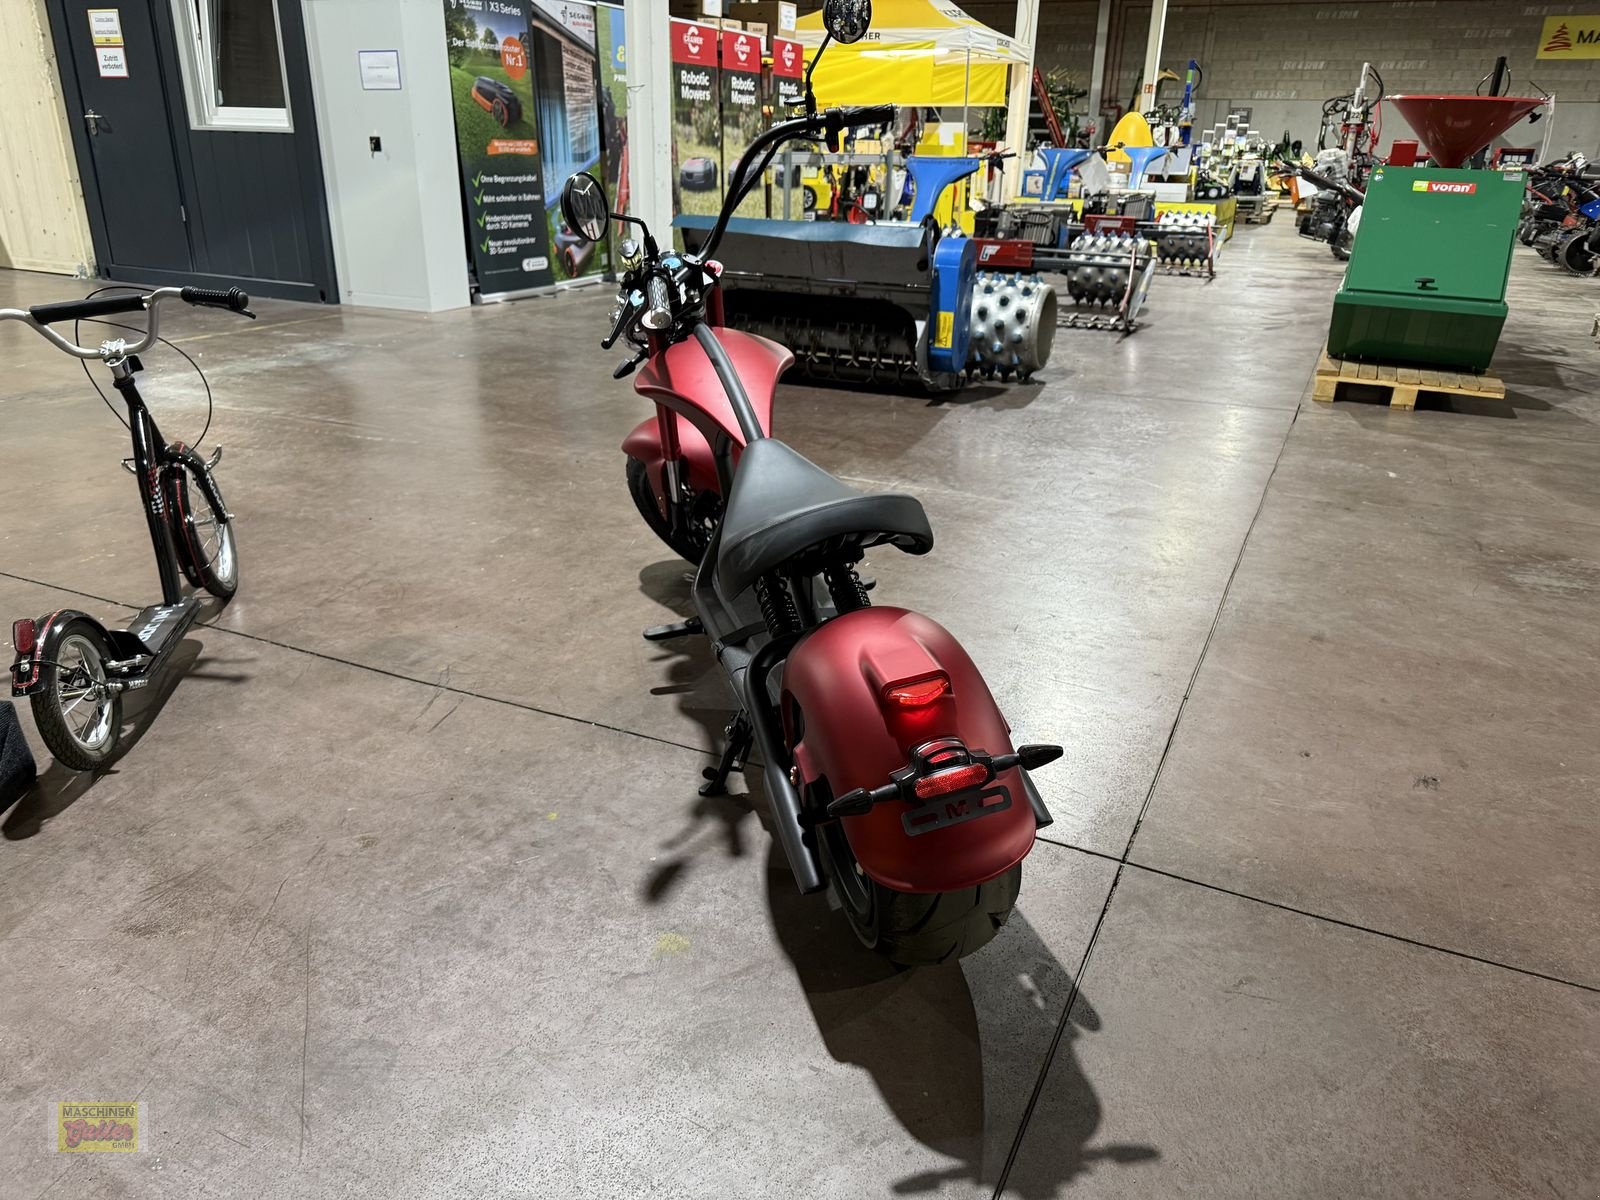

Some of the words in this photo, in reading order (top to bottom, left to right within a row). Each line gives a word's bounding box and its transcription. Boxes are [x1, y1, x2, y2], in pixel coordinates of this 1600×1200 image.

[489, 2, 499, 13] X3
[501, 4, 521, 16] Series
[452, 37, 464, 46] Der
[861, 32, 881, 40] HER
[680, 70, 710, 86] Robotic
[731, 76, 755, 92] Robotic
[681, 85, 711, 101] Mowers
[779, 82, 798, 96] Robotic
[731, 91, 756, 105] Mowers
[1431, 184, 1470, 193] voran
